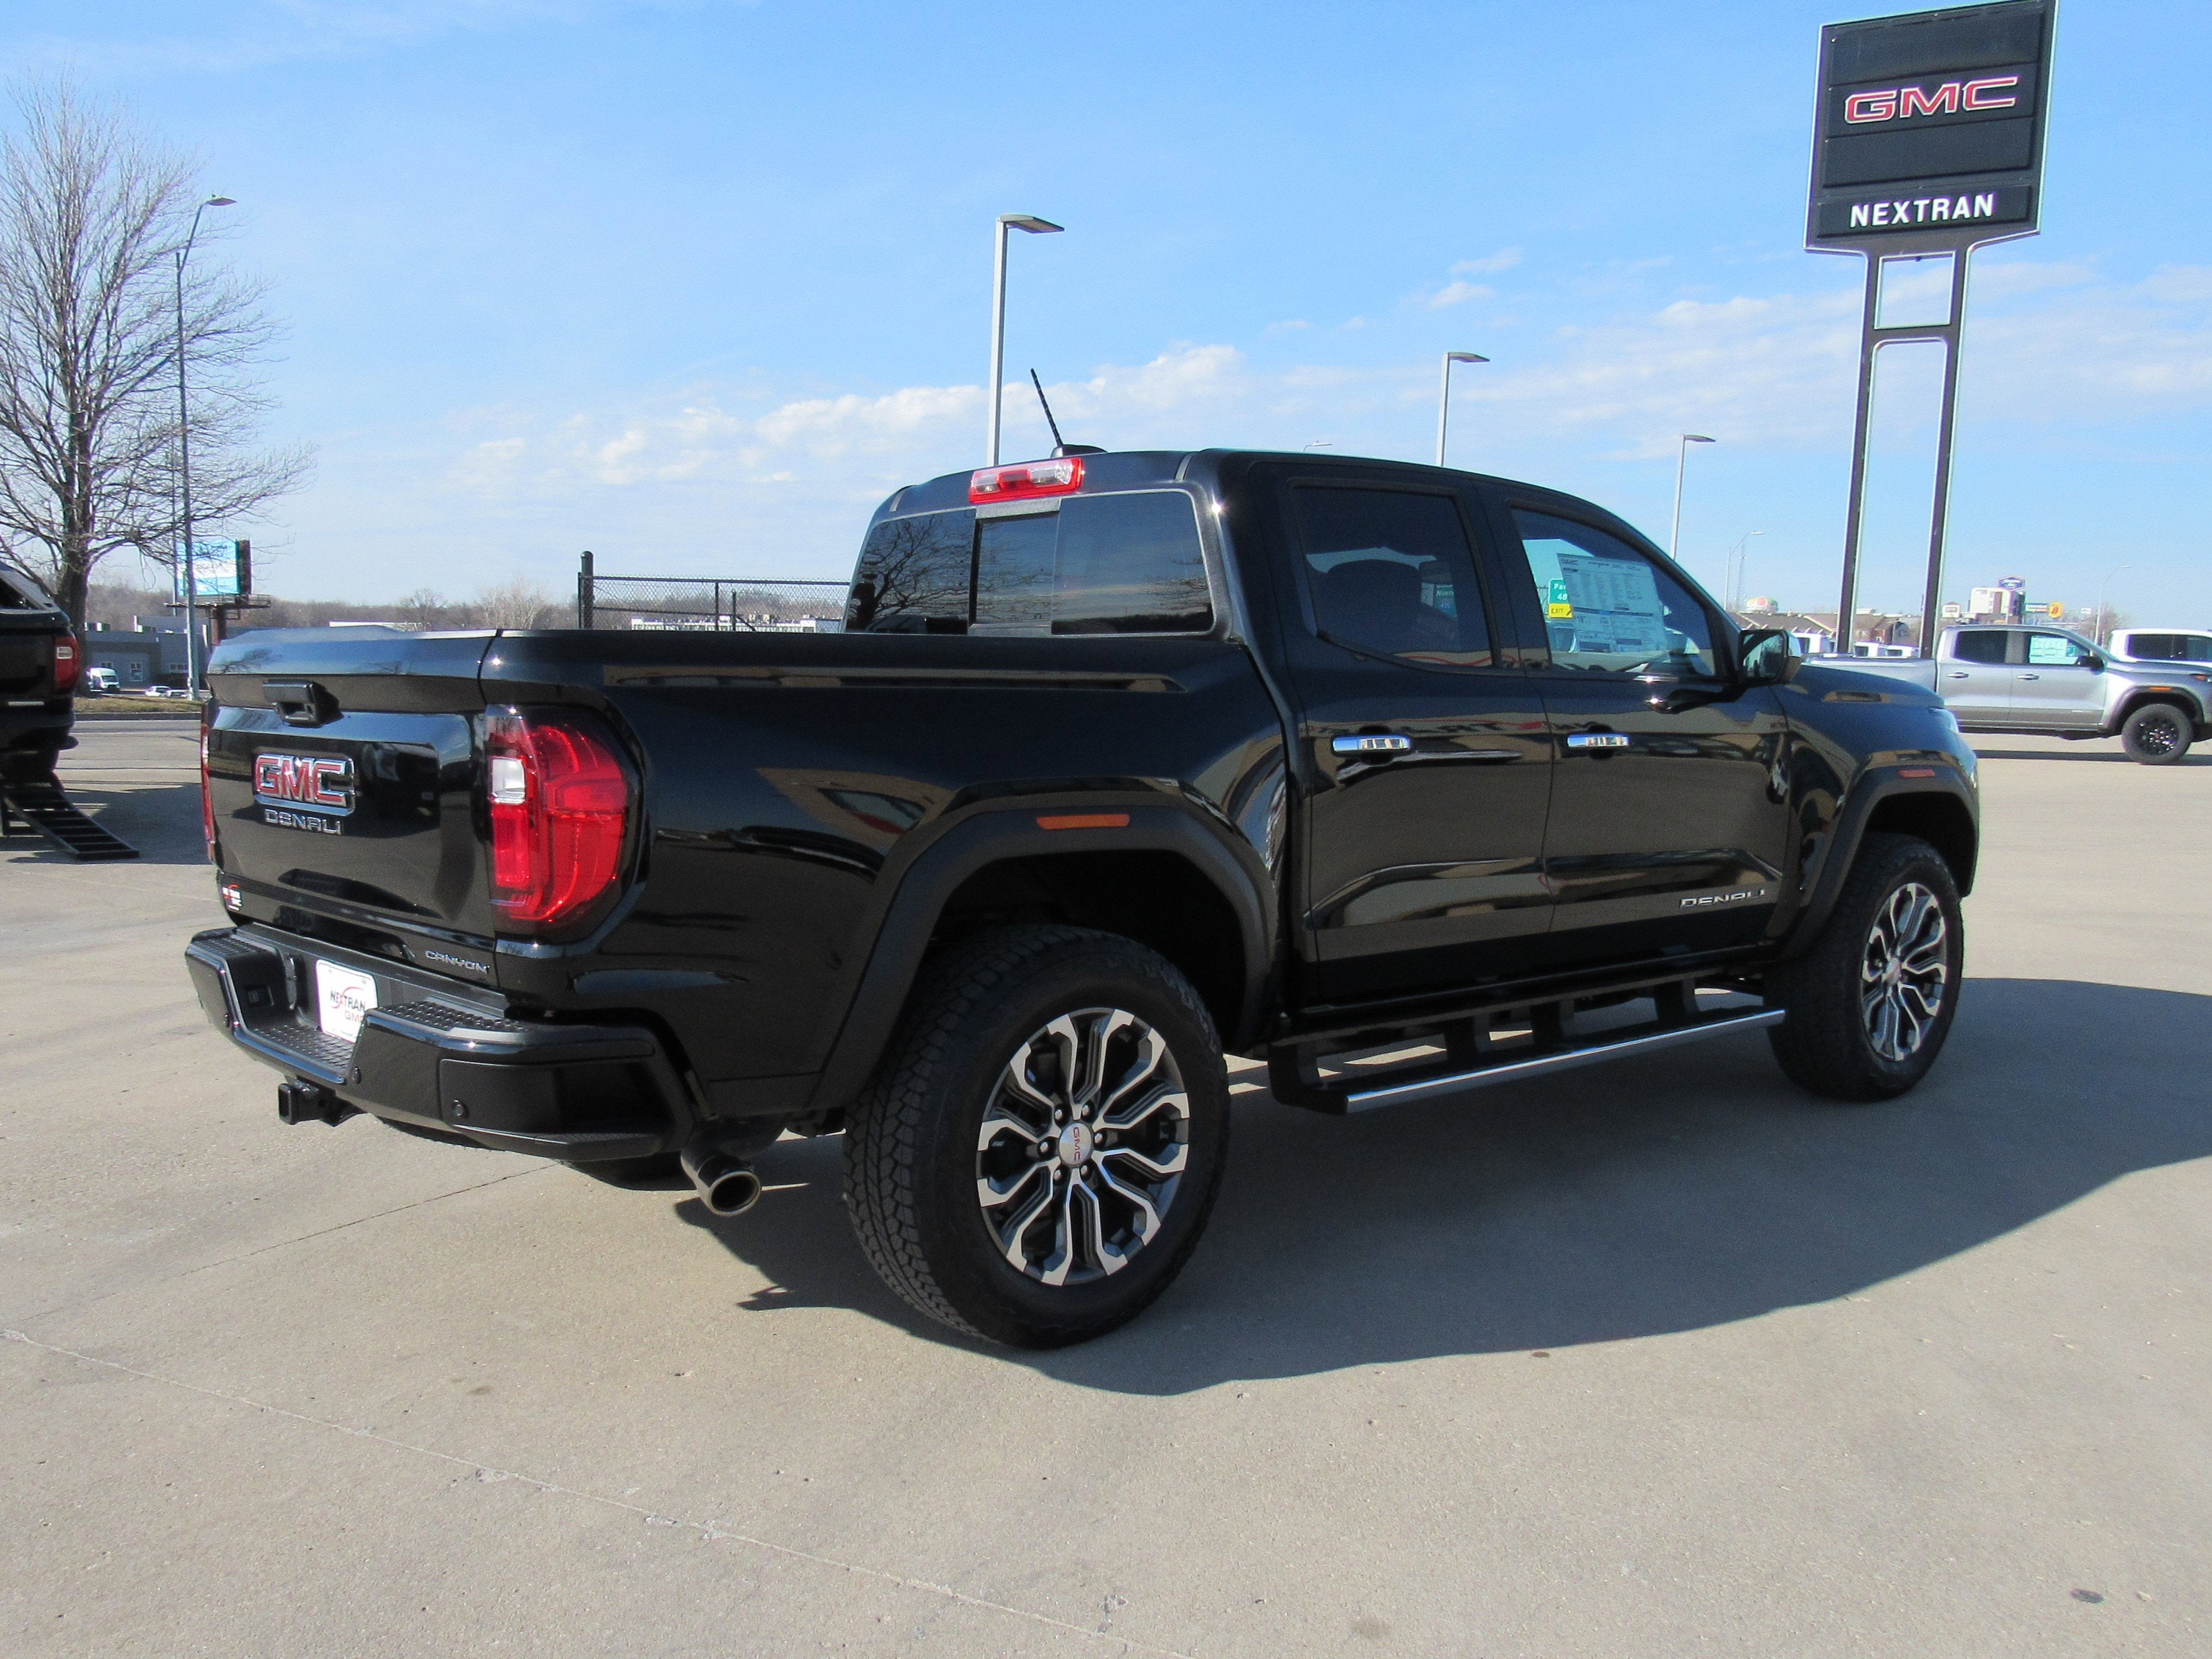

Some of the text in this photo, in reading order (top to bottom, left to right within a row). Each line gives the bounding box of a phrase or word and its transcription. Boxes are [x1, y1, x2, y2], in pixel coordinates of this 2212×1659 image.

[1844, 76, 2018, 124] GMC
[1849, 194, 1994, 228] NEXTRAN
[255, 754, 348, 807] GMC
[265, 808, 342, 836] DENALI
[1680, 889, 1765, 908] DENALI
[426, 950, 487, 974] CANYON
[330, 990, 366, 1011] NEXTRAN
